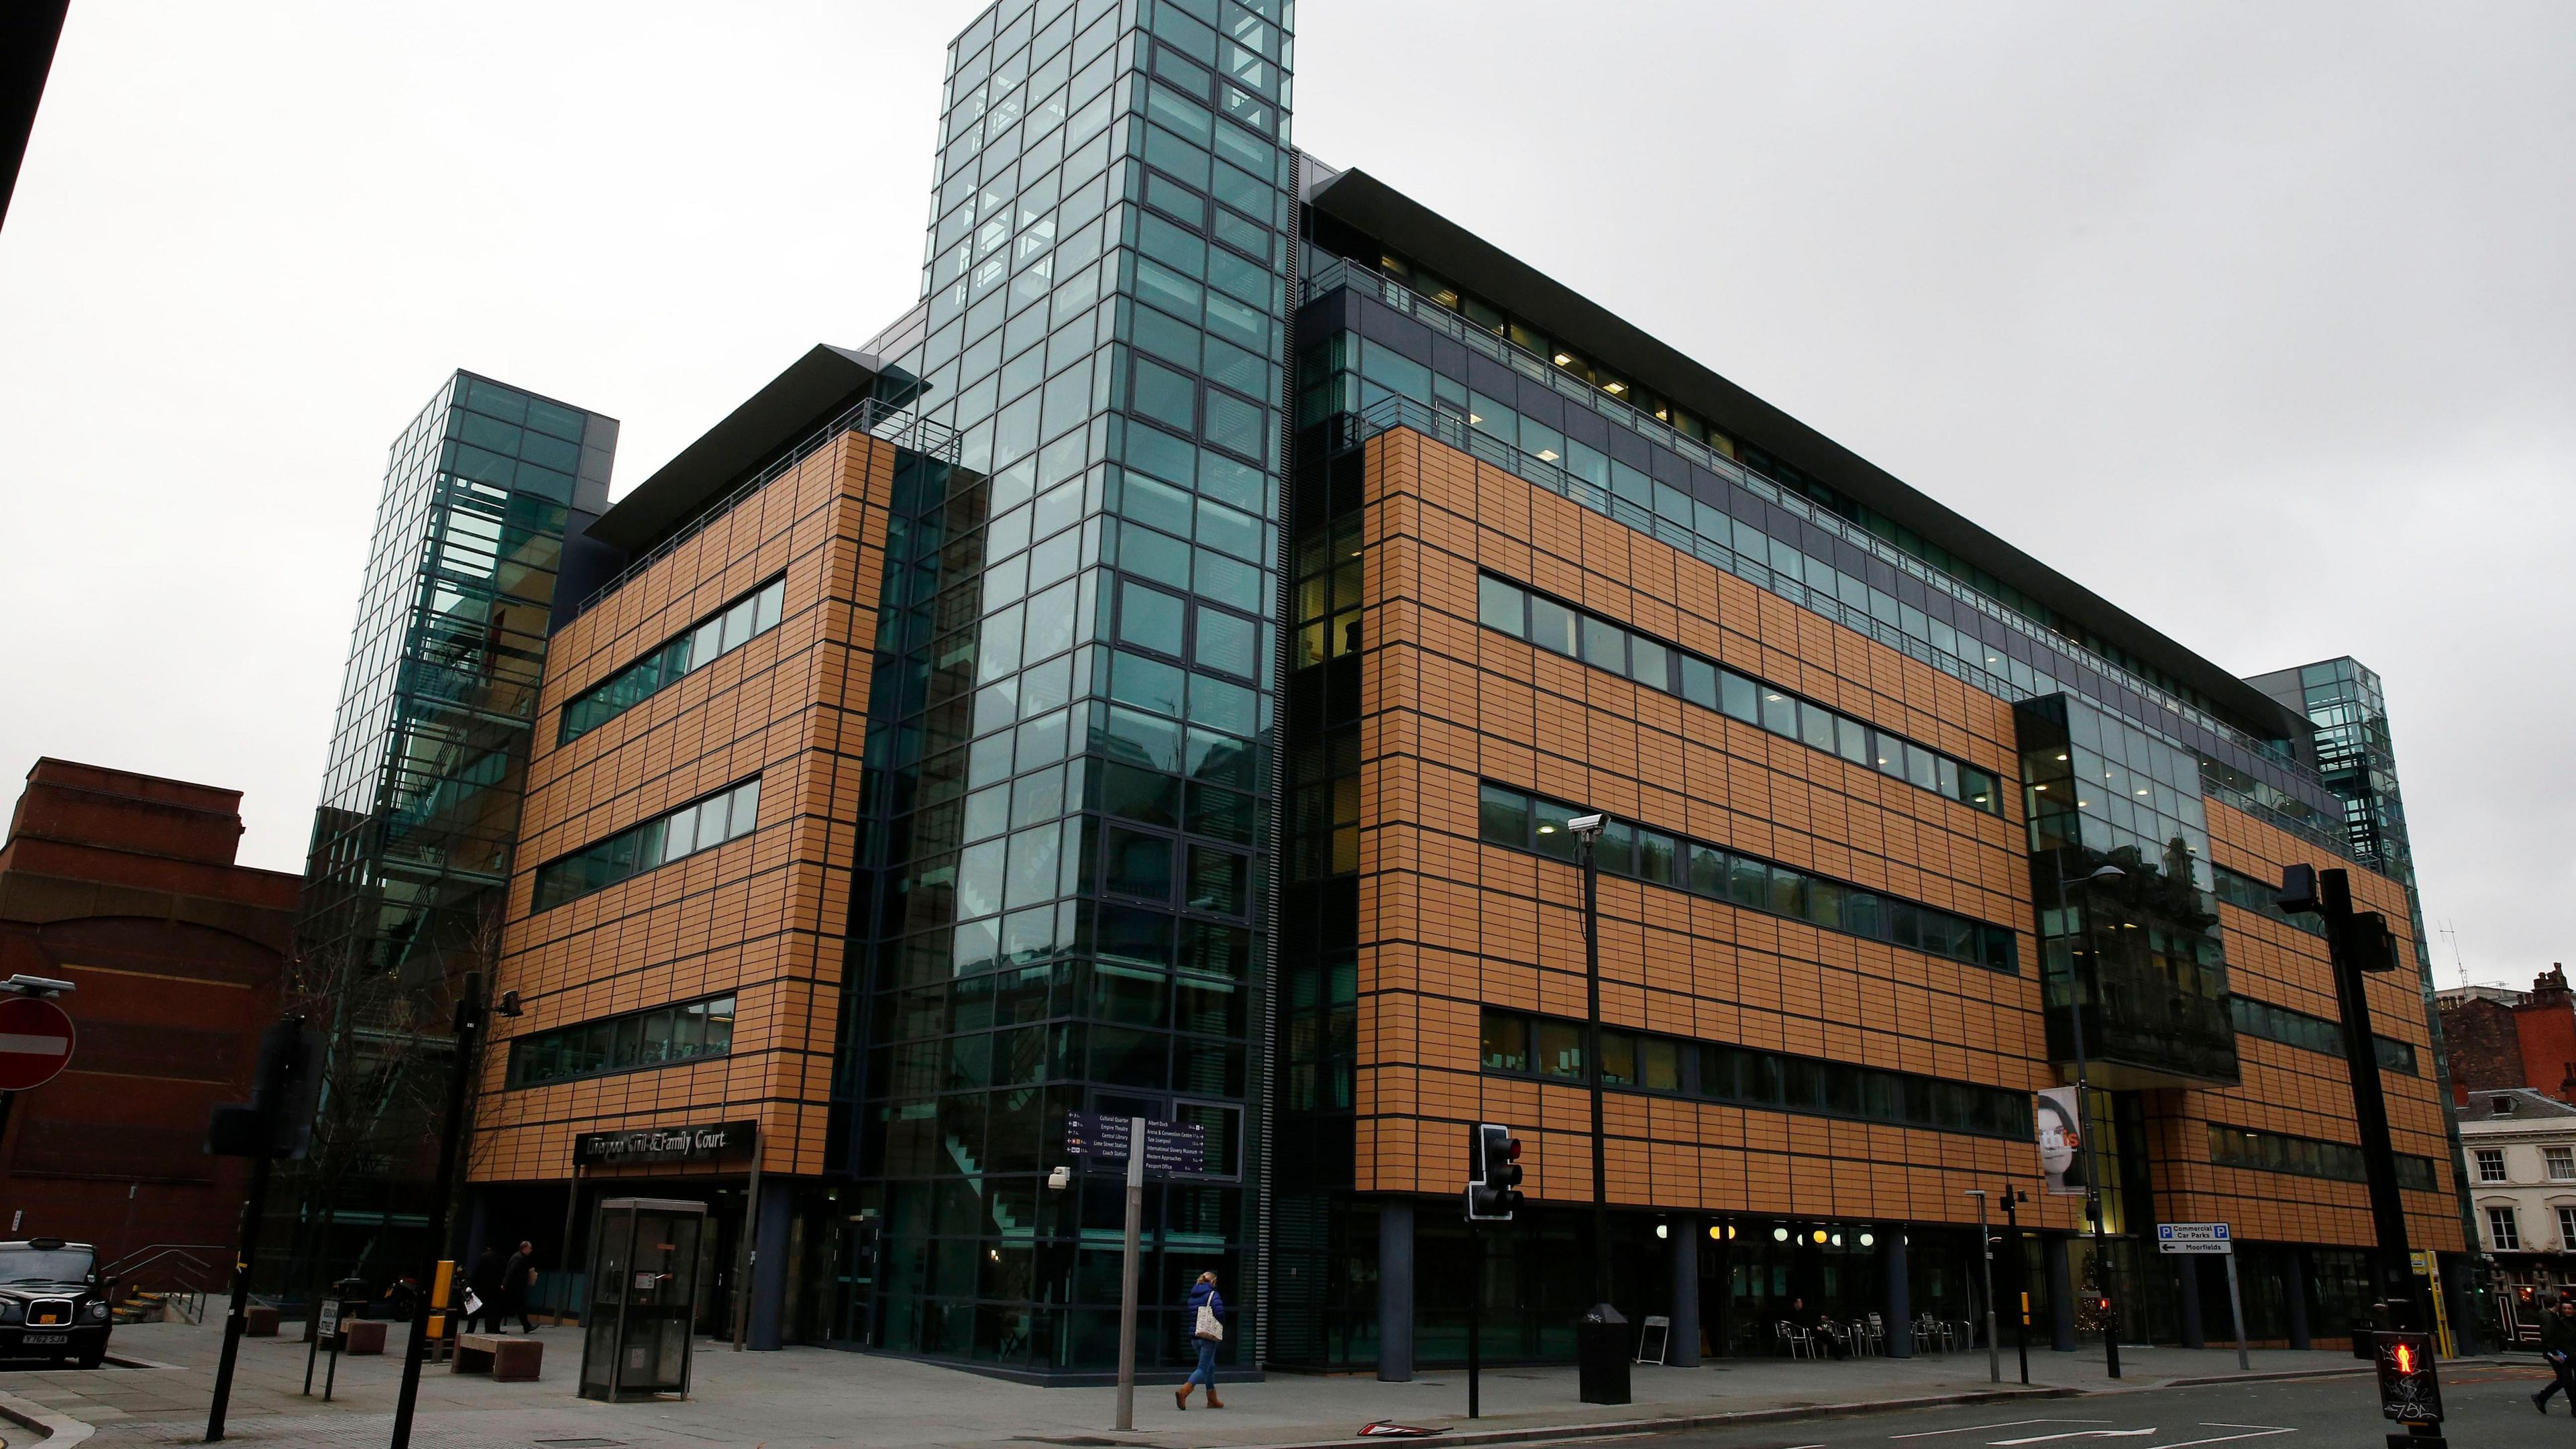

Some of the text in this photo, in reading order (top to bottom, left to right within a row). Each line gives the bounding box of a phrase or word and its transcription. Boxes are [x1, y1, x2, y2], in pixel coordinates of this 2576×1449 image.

[586, 1138, 624, 1156] Liverpool
[627, 1134, 647, 1152] Civil
[661, 1131, 692, 1156] Family
[695, 1130, 724, 1148] Court
[2041, 1128, 2080, 1148] this
[2163, 1227, 2170, 1238] P
[2217, 1226, 2225, 1237] P
